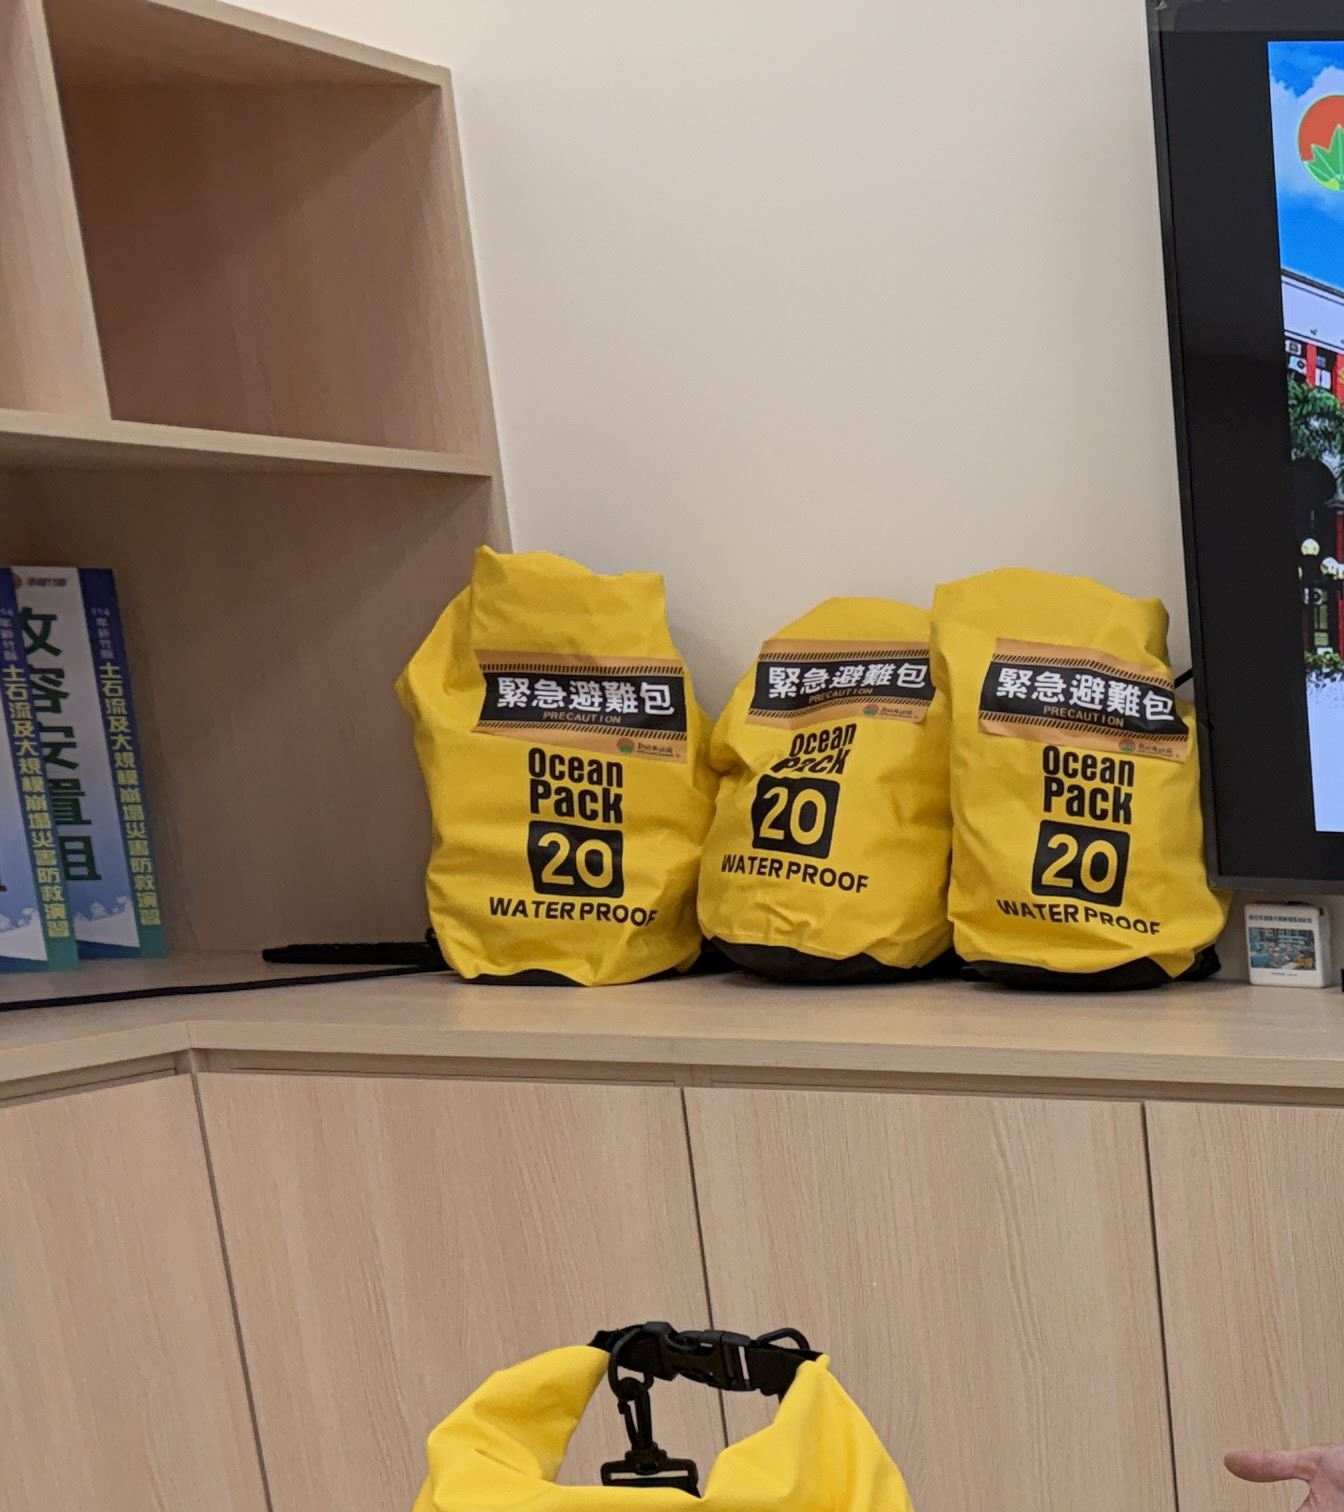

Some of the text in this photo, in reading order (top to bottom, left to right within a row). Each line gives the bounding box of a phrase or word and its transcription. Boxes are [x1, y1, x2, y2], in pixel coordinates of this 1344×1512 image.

[496, 677, 675, 716] 緊急避難包
[768, 662, 928, 699] 緊急避難包
[996, 667, 1175, 721] 緊急避難包
[543, 711, 622, 724] PRECAUTION
[1042, 706, 1125, 729] PRECAUTION
[788, 722, 857, 757] Ocean
[528, 748, 624, 788] Ocean
[1042, 745, 1135, 787] Ocean
[529, 778, 623, 824] Pack
[758, 785, 828, 846] 20
[1042, 776, 1132, 825] Pack
[535, 831, 614, 889] 20
[1040, 833, 1118, 894] 20
